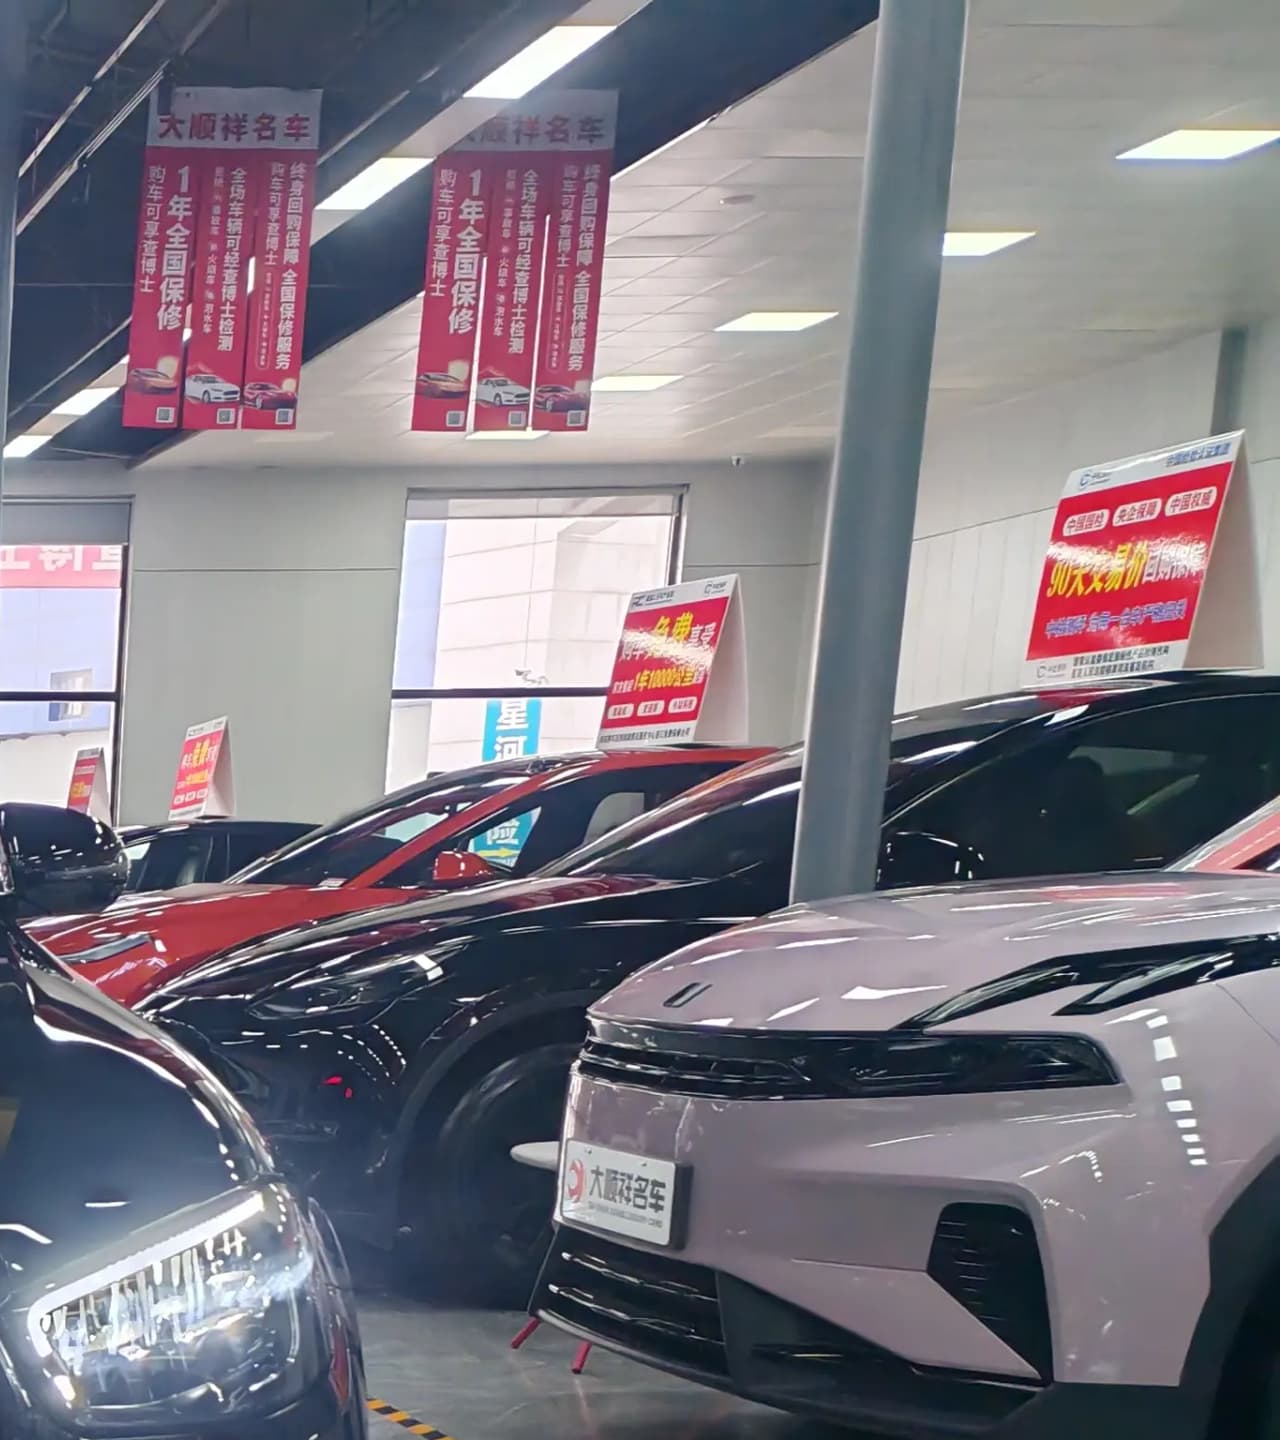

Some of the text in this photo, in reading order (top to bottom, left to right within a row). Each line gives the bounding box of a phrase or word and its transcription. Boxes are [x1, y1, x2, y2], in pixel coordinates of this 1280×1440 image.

[158, 112, 311, 142] 大顺祥名车
[157, 165, 192, 331] 1年全国保修
[448, 169, 485, 334] 1年全国保修
[589, 1165, 666, 1213] 大顺祥名车
